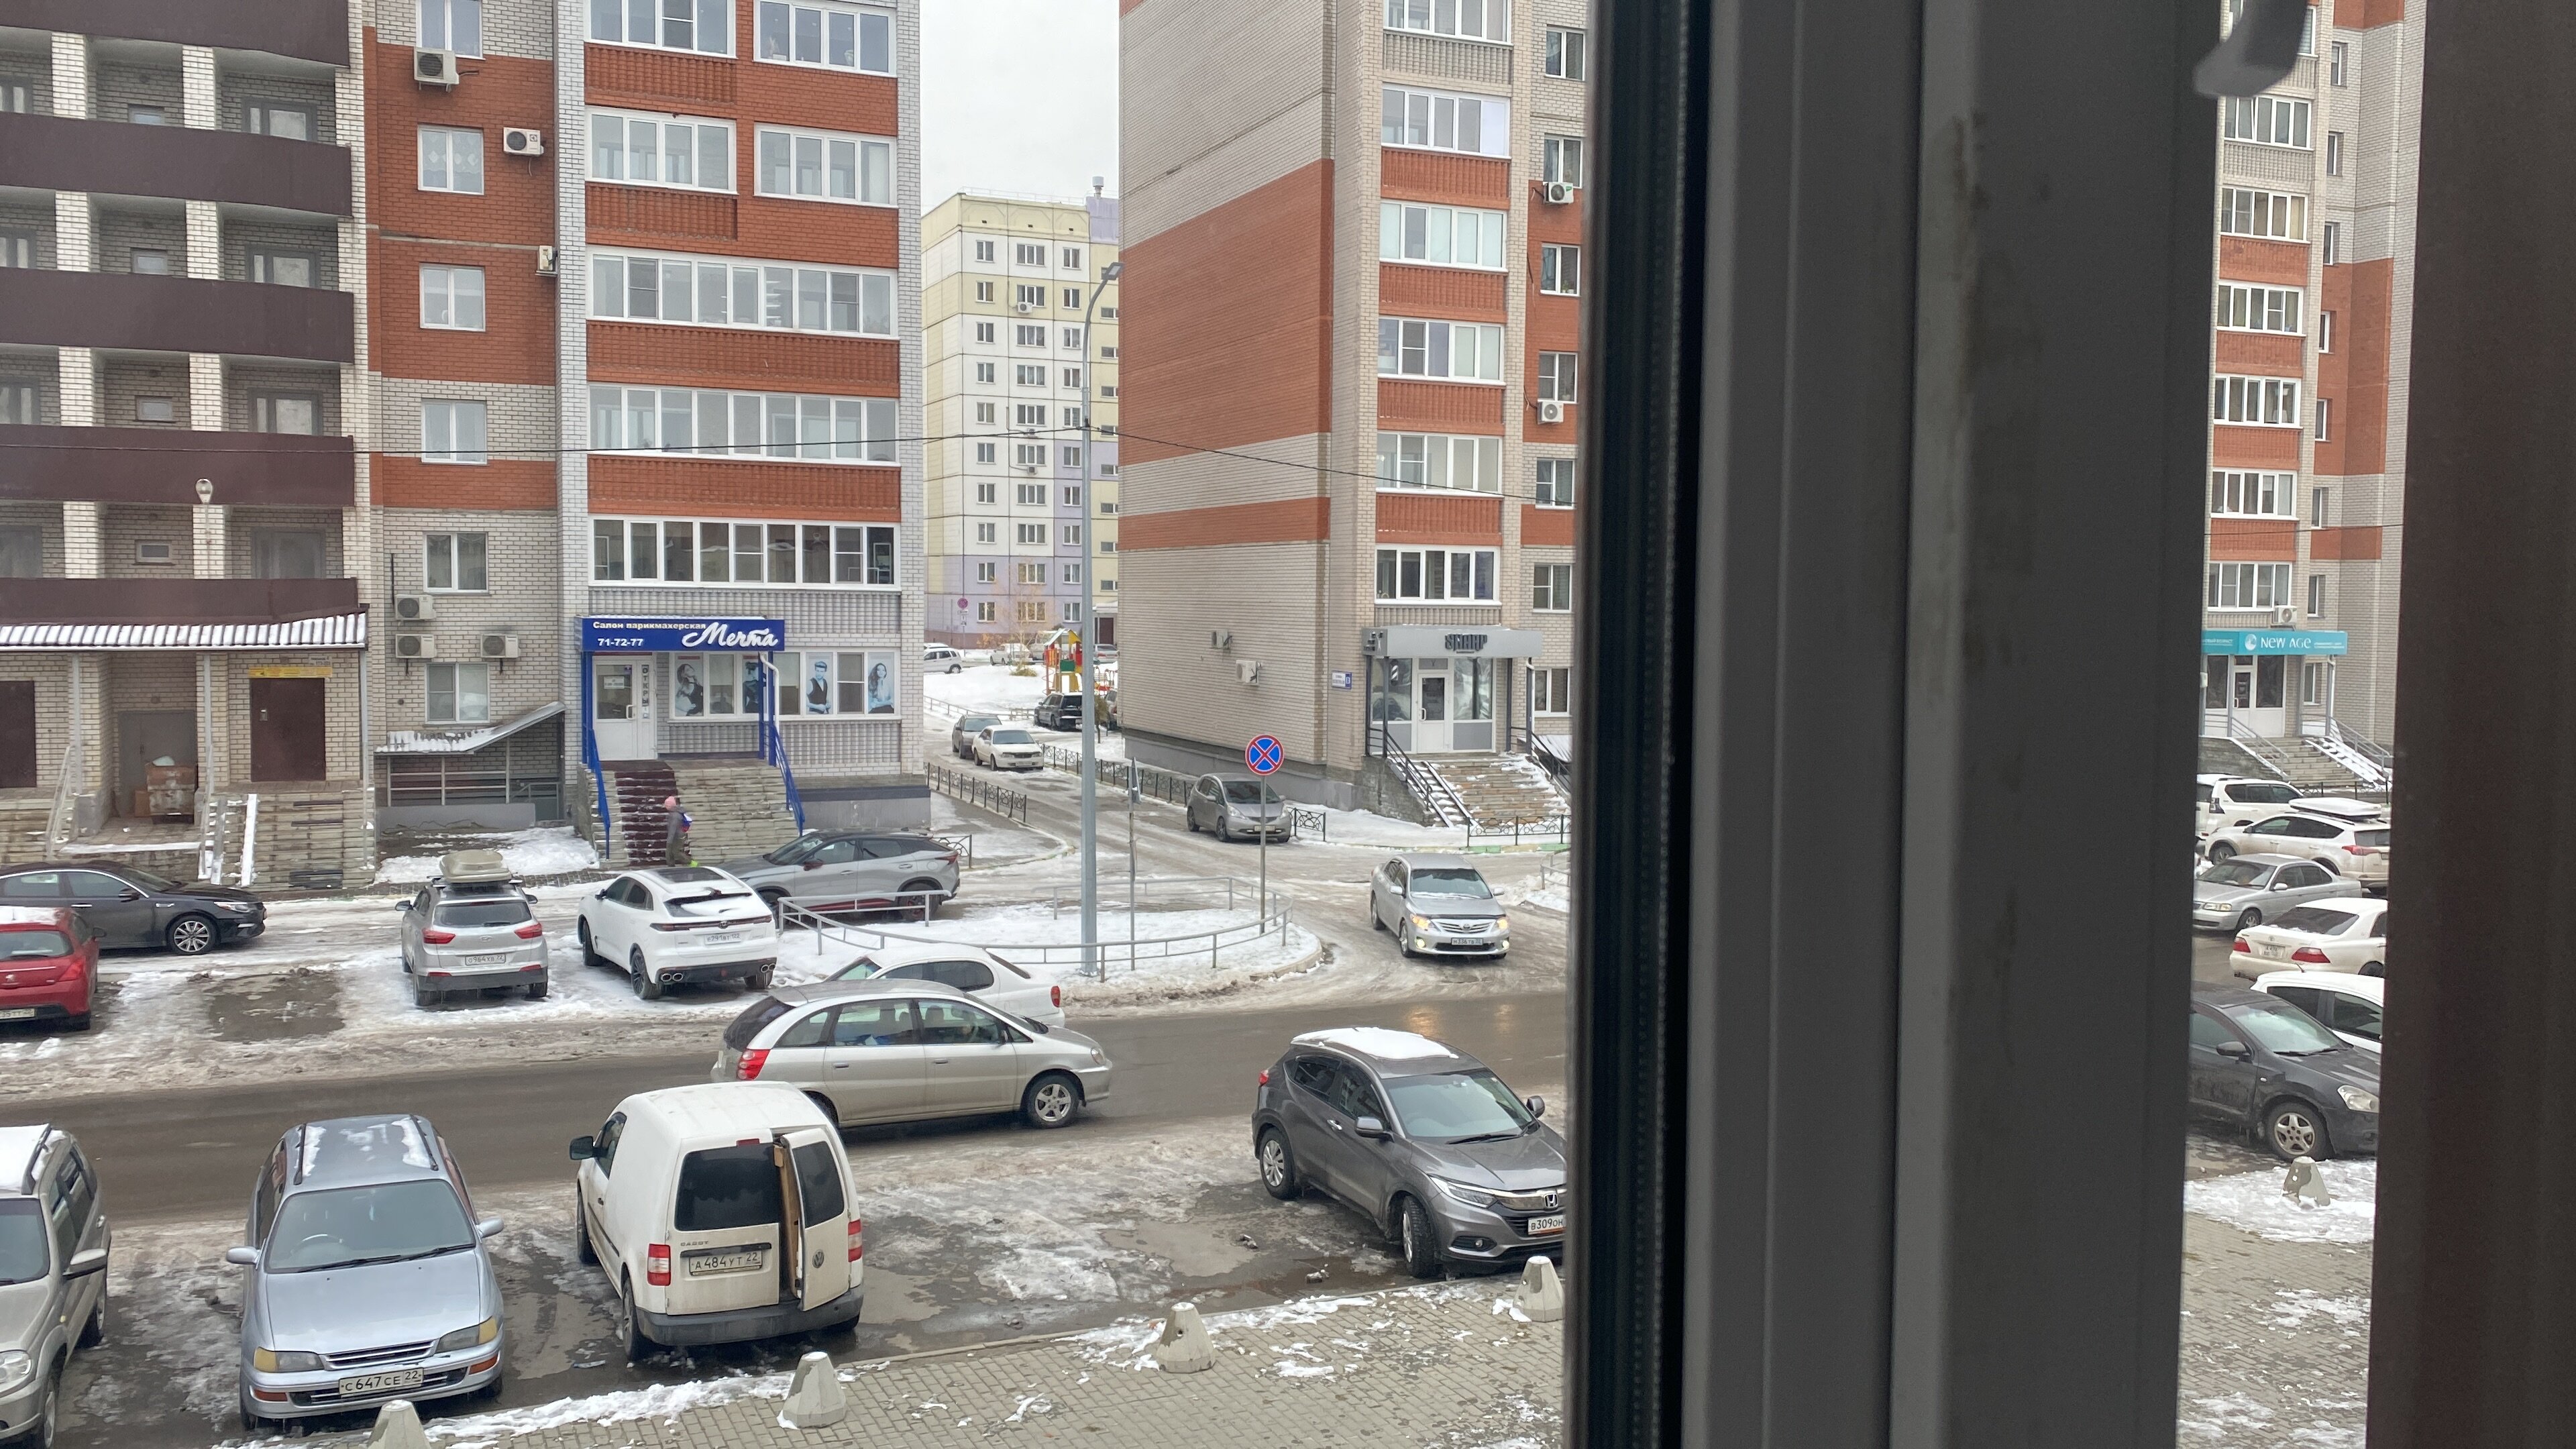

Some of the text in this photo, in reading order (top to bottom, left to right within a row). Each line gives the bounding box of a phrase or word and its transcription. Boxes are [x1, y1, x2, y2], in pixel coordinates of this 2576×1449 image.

[626, 622, 706, 630] парикмахерская
[682, 622, 778, 647] Мечта
[597, 638, 643, 647] 71-72-77
[1531, 1218, 1563, 1230] В309ОН
[695, 1252, 757, 1270] А484УТ 22
[345, 1371, 418, 1391] С647СЕ 22
